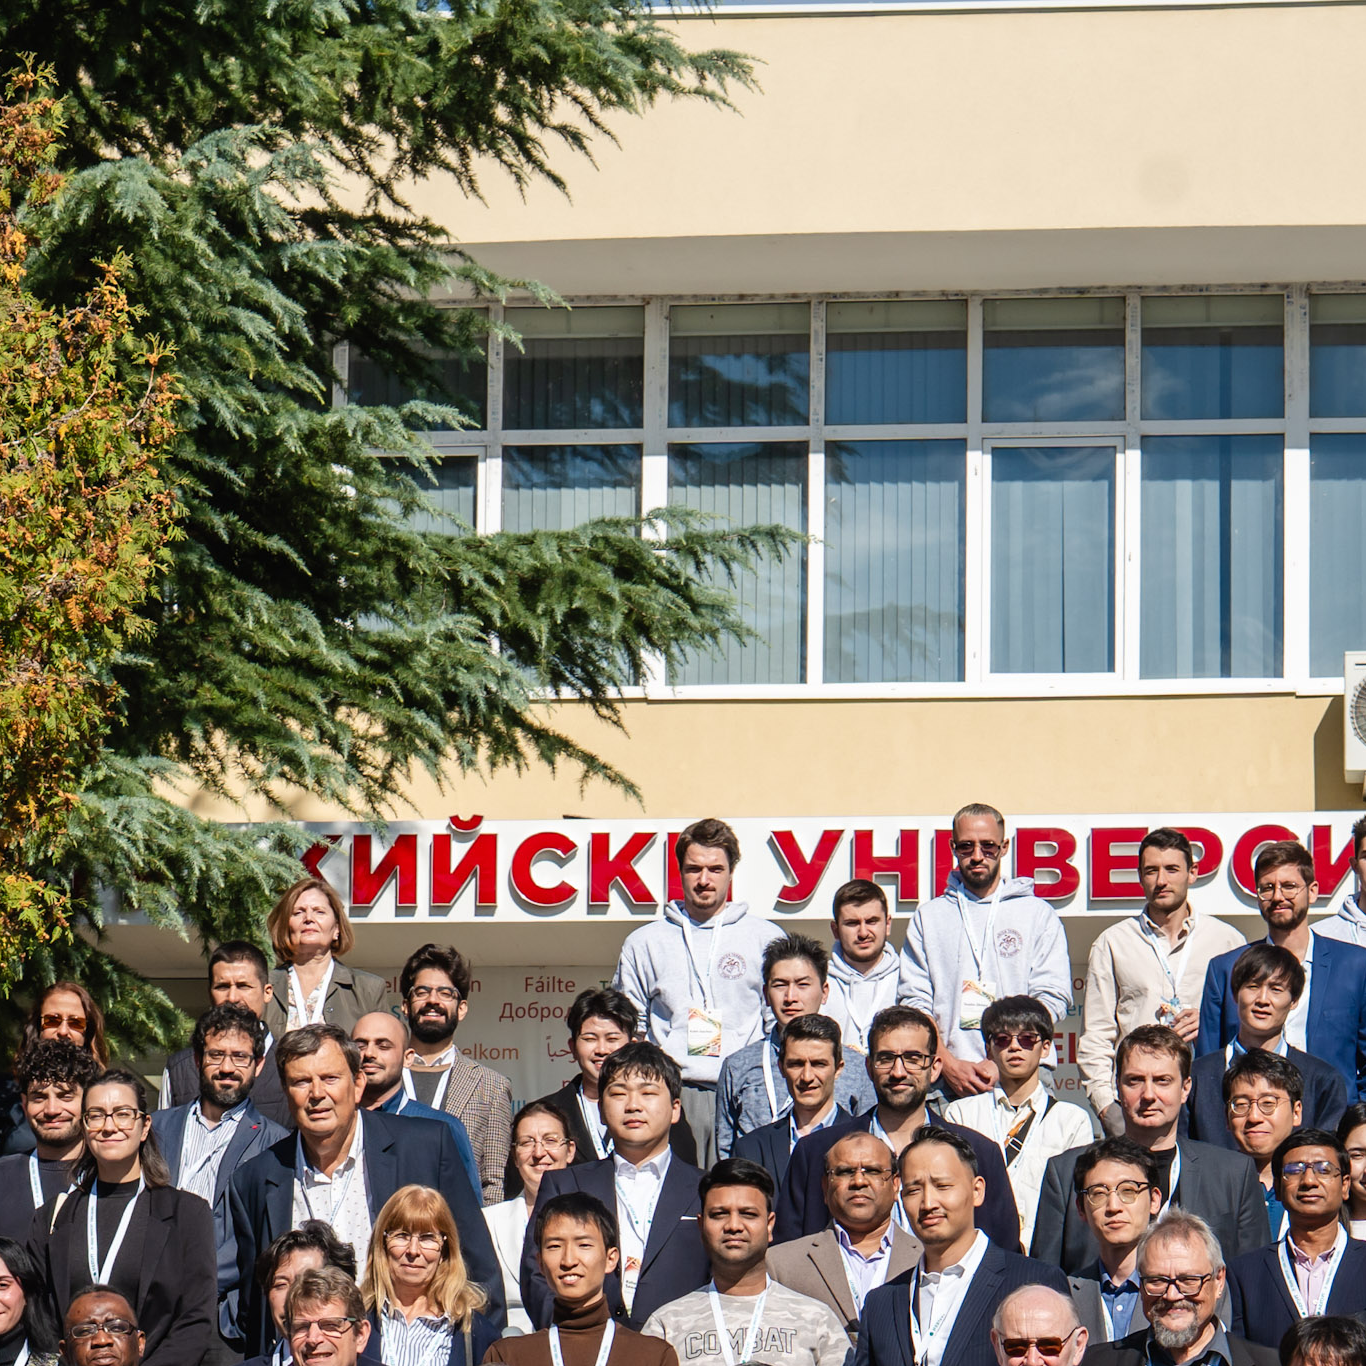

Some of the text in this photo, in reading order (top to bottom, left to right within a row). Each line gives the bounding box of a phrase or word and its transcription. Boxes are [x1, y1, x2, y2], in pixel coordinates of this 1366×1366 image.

[524, 975, 576, 993] Fáilte
[461, 1043, 520, 1060] elkom
[685, 1327, 797, 1359] COMBAT
